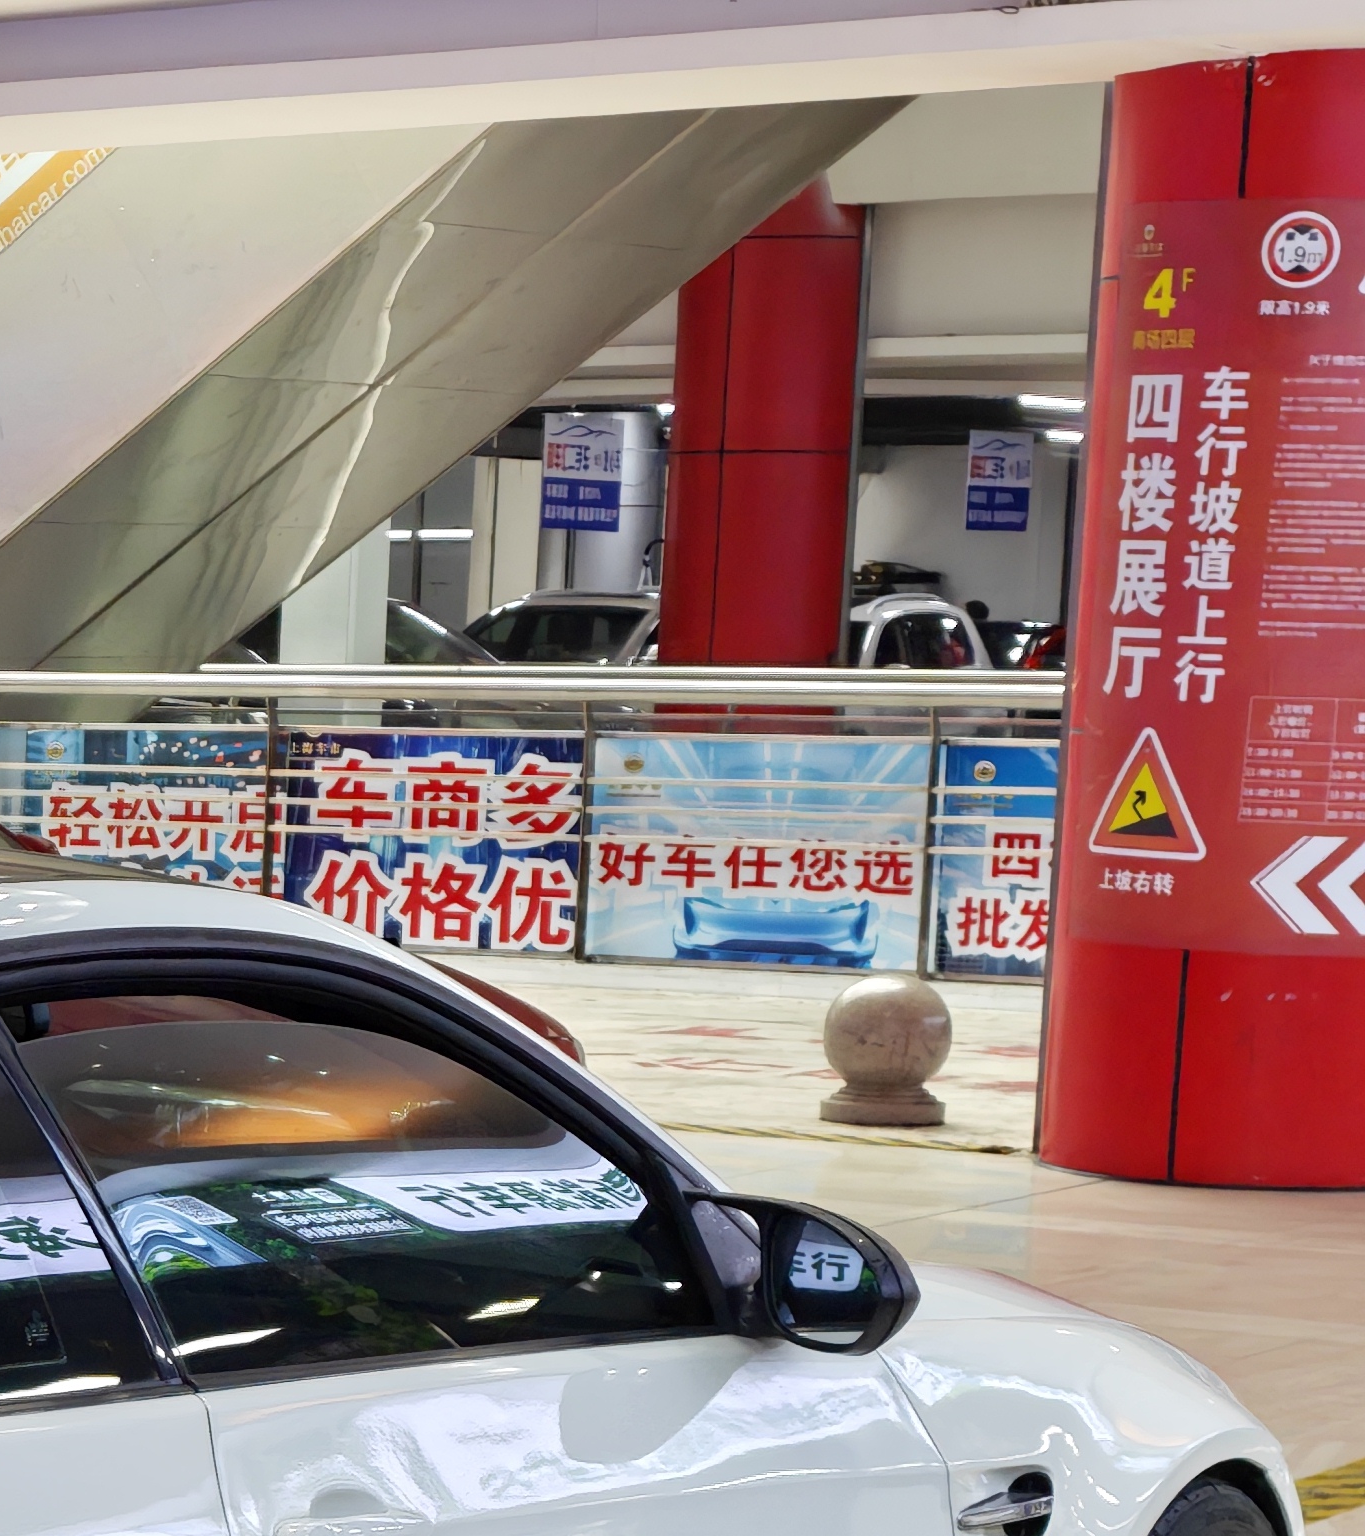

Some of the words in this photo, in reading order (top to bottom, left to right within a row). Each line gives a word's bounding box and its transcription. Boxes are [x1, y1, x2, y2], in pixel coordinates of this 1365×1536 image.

[1278, 246, 1325, 264] 1.9m
[1102, 373, 1185, 698] 四楼展厅
[1174, 366, 1251, 704] 车行坡道上行
[316, 758, 573, 835] 车商多
[597, 832, 914, 896] 好车任您选
[991, 832, 1053, 879] 四
[1098, 868, 1175, 897] 上坡右转
[313, 857, 571, 945] 价格优
